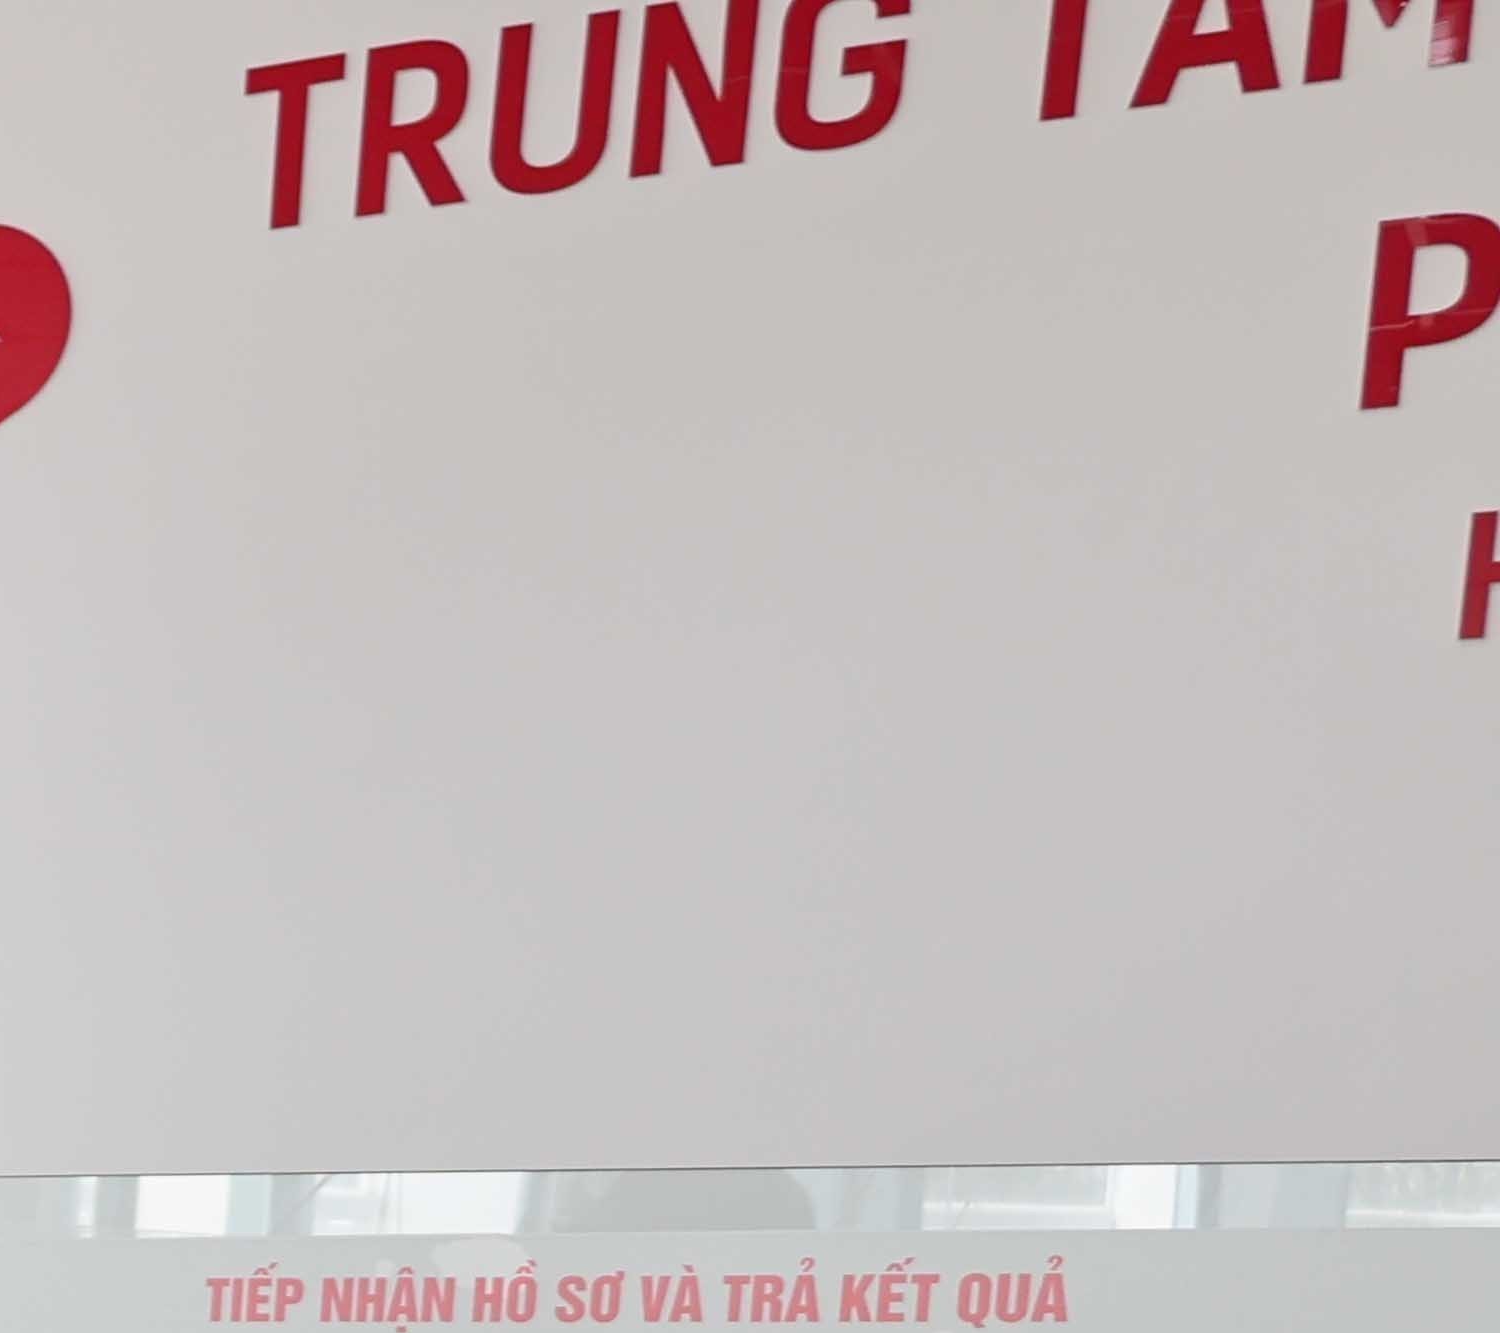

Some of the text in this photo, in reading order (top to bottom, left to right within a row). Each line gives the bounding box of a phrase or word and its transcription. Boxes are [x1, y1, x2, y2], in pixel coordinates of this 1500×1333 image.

[244, 0, 911, 232] TRUNG
[205, 1254, 1068, 1333] TIẾP NHẬN HỒ SƠ VÀ TRẢ KẾT QUẢ
